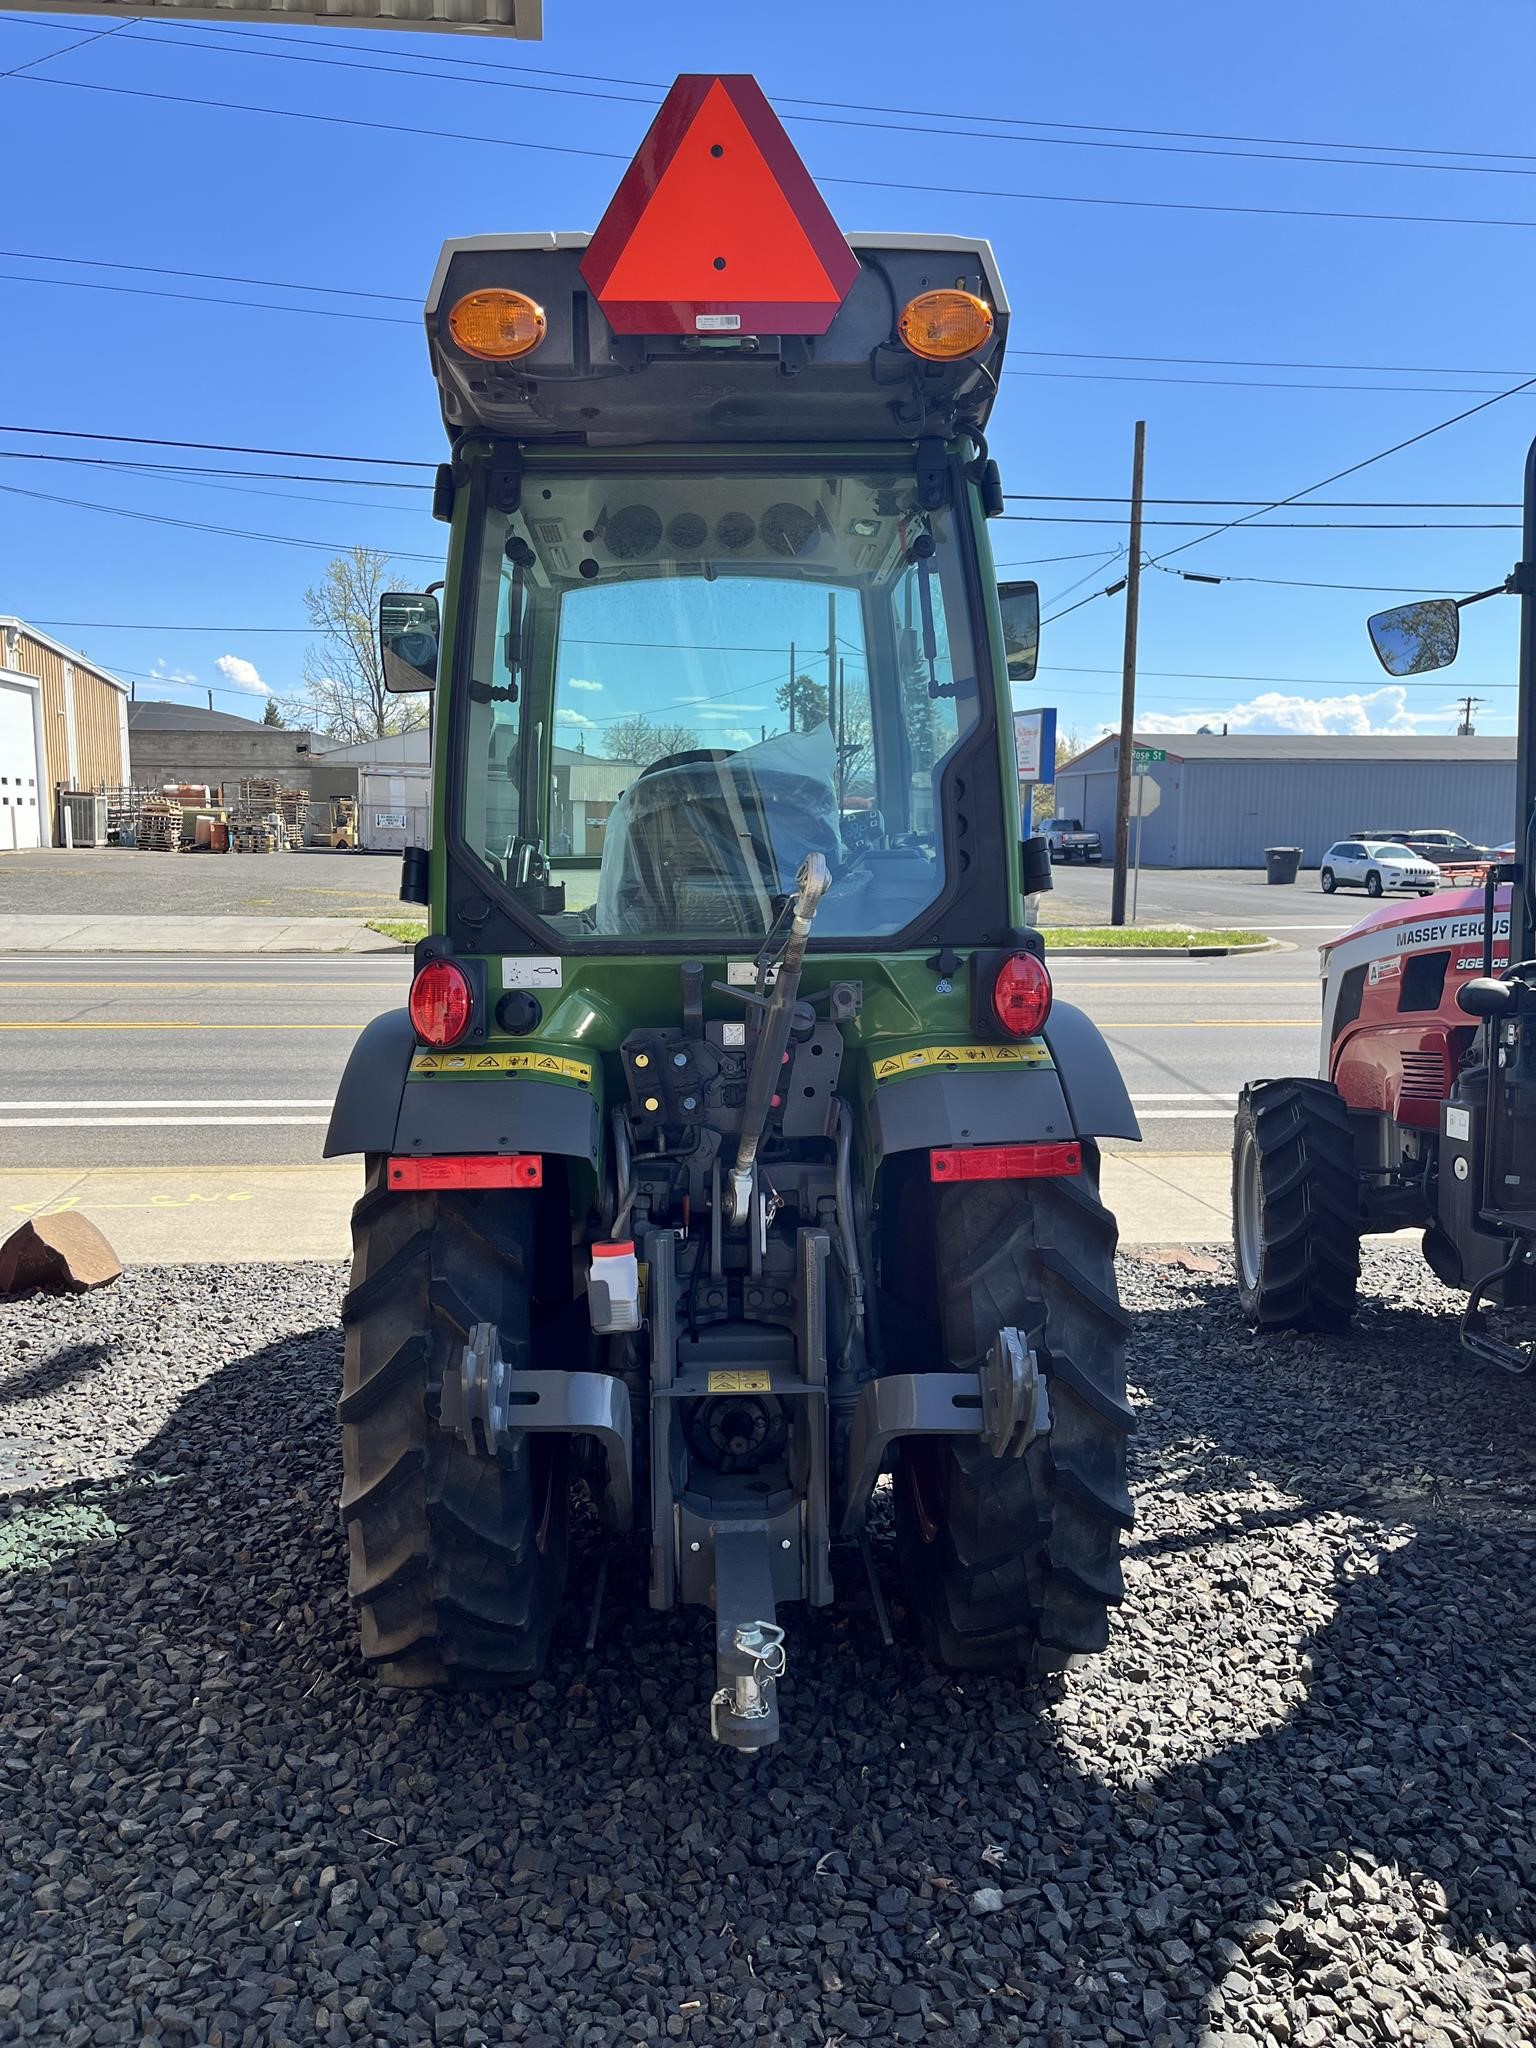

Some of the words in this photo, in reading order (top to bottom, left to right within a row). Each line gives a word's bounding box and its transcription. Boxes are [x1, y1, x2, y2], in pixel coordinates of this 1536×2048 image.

[1131, 750, 1150, 760] Rose
[1152, 751, 1162, 760] St
[1396, 925, 1448, 947] MASSEY
[1451, 919, 1510, 938] FERGUS
[1456, 958, 1509, 970] 3GE05
